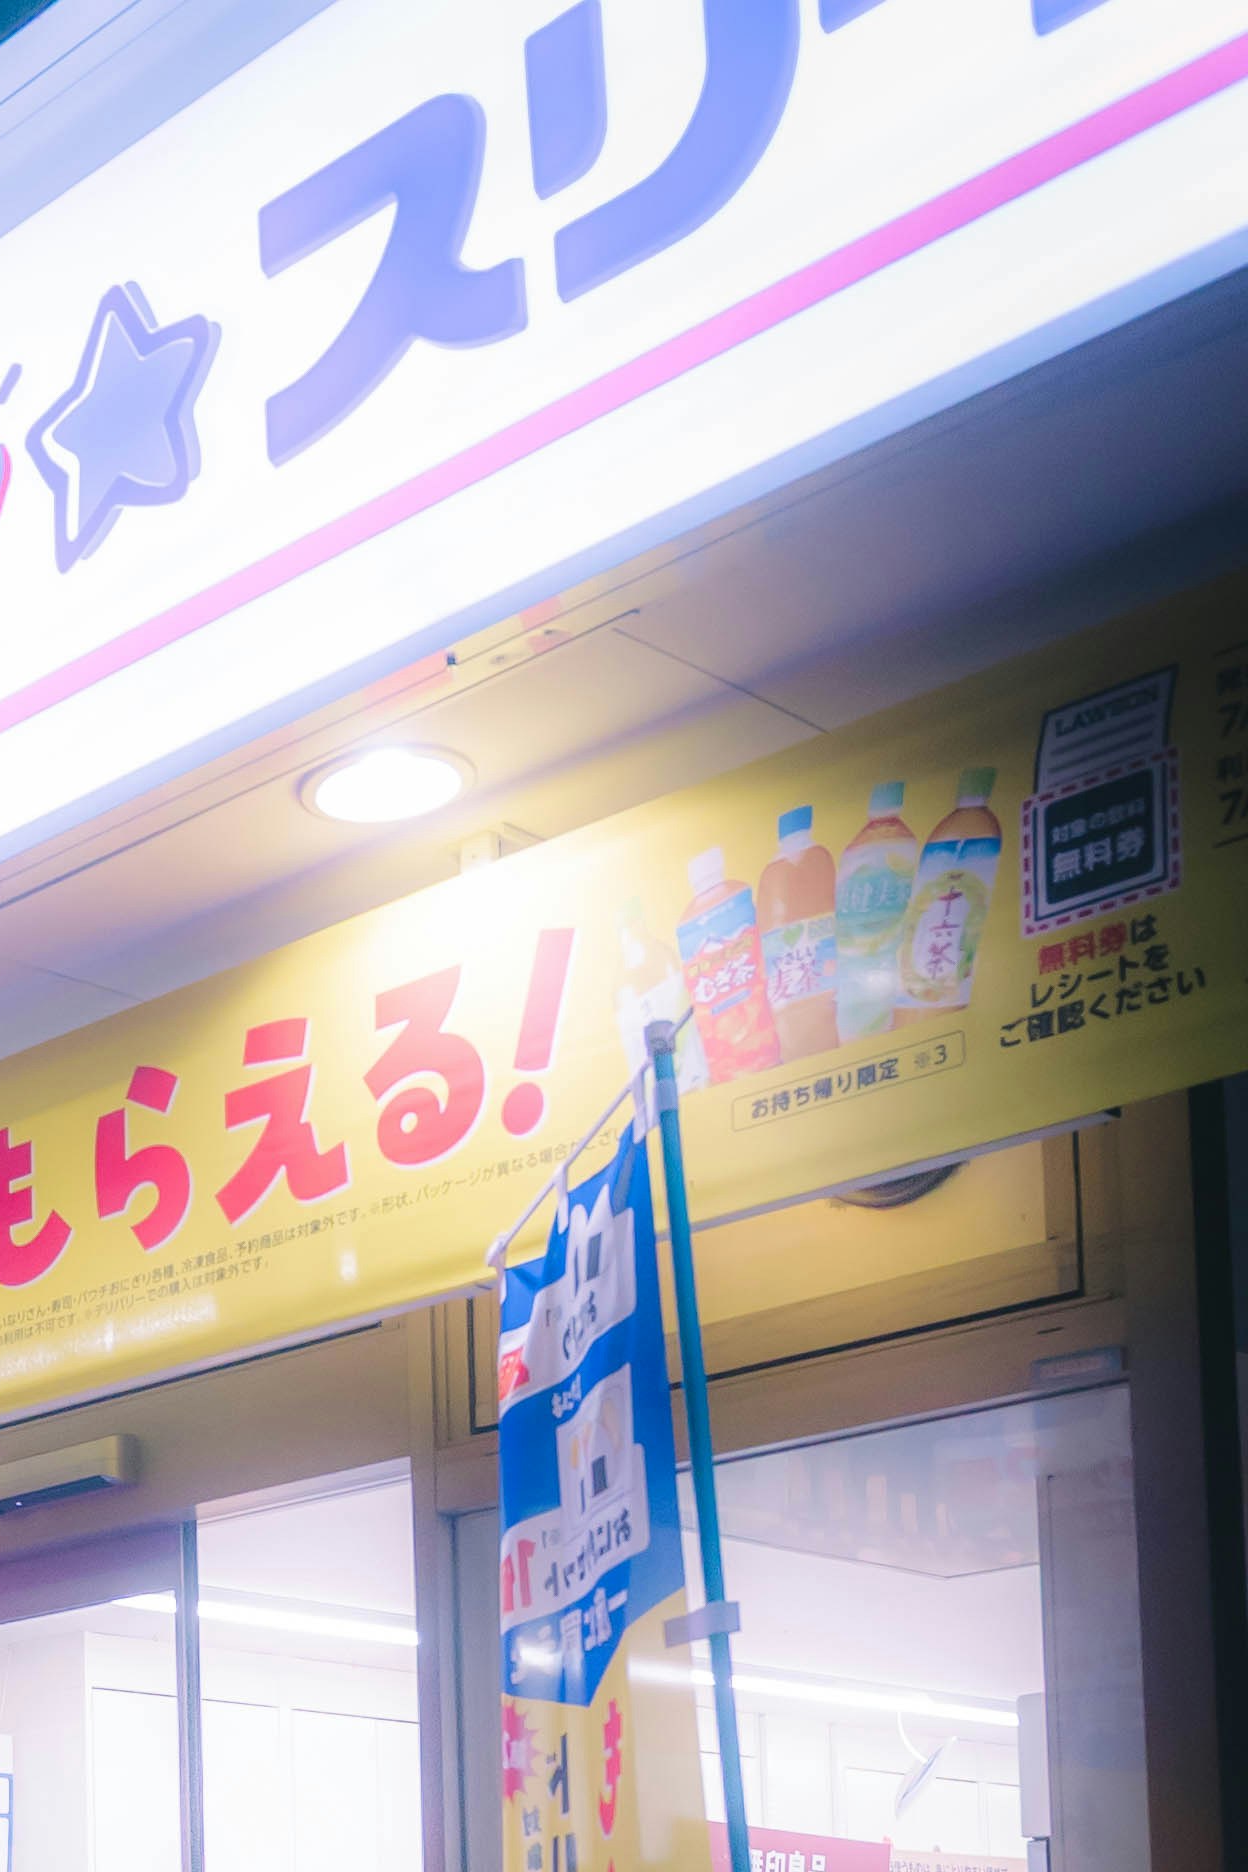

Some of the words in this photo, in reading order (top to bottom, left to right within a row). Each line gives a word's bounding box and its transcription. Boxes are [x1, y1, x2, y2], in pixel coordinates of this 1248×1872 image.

[999, 965, 1207, 1047] ご確認ください
[1031, 943, 1170, 1009] レシートを
[751, 1058, 900, 1121] お持ち帰り限定
